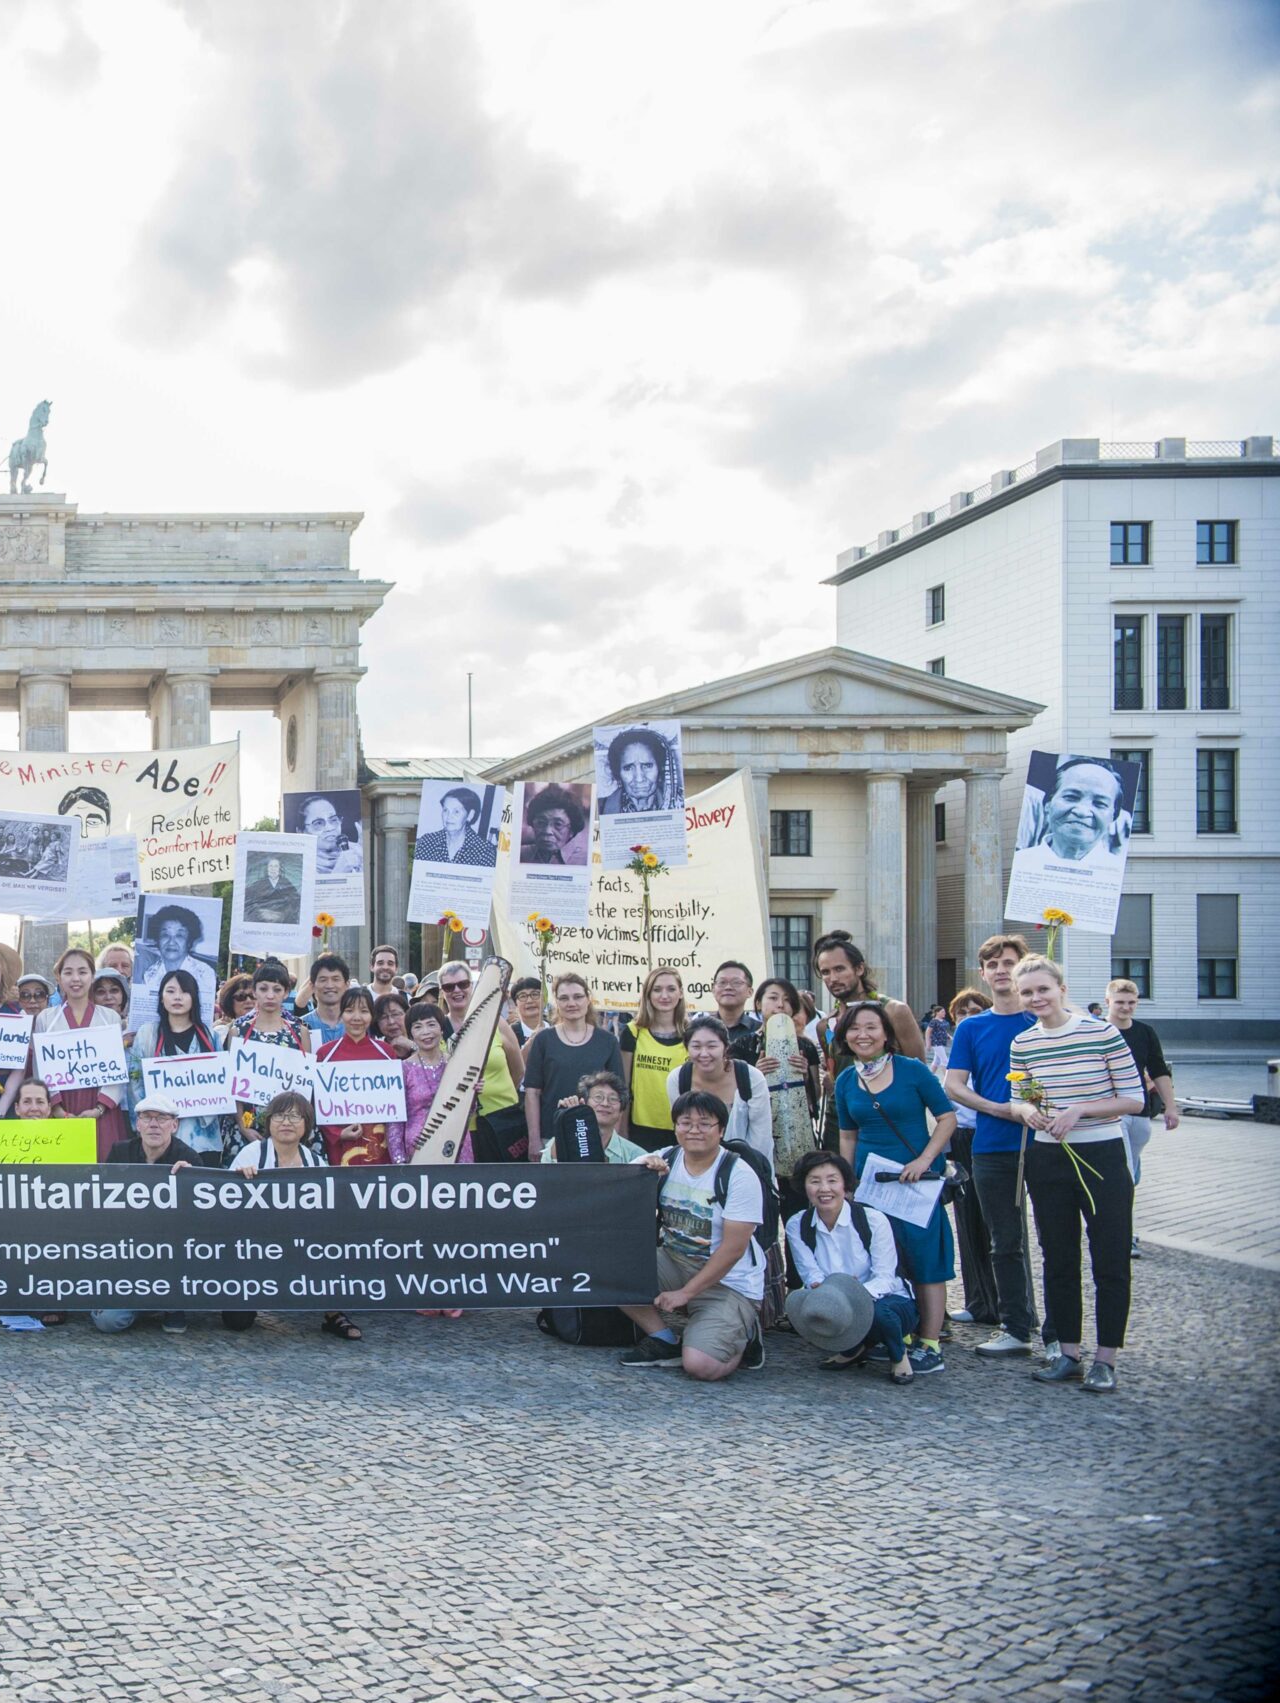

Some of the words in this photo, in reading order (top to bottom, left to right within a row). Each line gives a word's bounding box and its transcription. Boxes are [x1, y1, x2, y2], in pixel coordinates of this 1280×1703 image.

[18, 755, 129, 786] Minister
[151, 806, 210, 835] Resolve
[213, 805, 232, 824] the
[686, 805, 736, 832] Slavery
[150, 863, 184, 881] issue
[186, 853, 230, 877] first!
[597, 876, 634, 893] facts.
[595, 902, 617, 918] the
[580, 926, 593, 939] to
[596, 925, 640, 941] victims
[595, 950, 640, 965] victims
[658, 951, 702, 967] proof.
[591, 976, 598, 990] it
[602, 980, 633, 992] never
[687, 978, 714, 999] agai
[42, 1040, 96, 1061] North
[636, 1054, 672, 1066] AMNESTY
[69, 1059, 120, 1079] Korea
[148, 1067, 225, 1089] Thailand
[236, 1049, 314, 1090] Malaysia
[636, 1063, 670, 1072] INTERNATIONAL
[44, 1072, 75, 1087] 220
[231, 1076, 250, 1098] 12
[317, 1066, 403, 1093] Vietnam
[173, 1096, 228, 1109] nknown
[318, 1099, 397, 1117] Unknown
[192, 1173, 335, 1209] sexual
[349, 1174, 537, 1209] violence
[183, 1237, 225, 1259] for
[234, 1238, 283, 1259] the
[293, 1238, 424, 1259] "comfort
[432, 1238, 559, 1259] women"
[18, 1274, 170, 1300] Japanese
[180, 1274, 278, 1300] troops
[288, 1273, 386, 1300] during
[395, 1272, 487, 1294] World
[496, 1272, 562, 1293] War
[572, 1272, 590, 1292] 2
